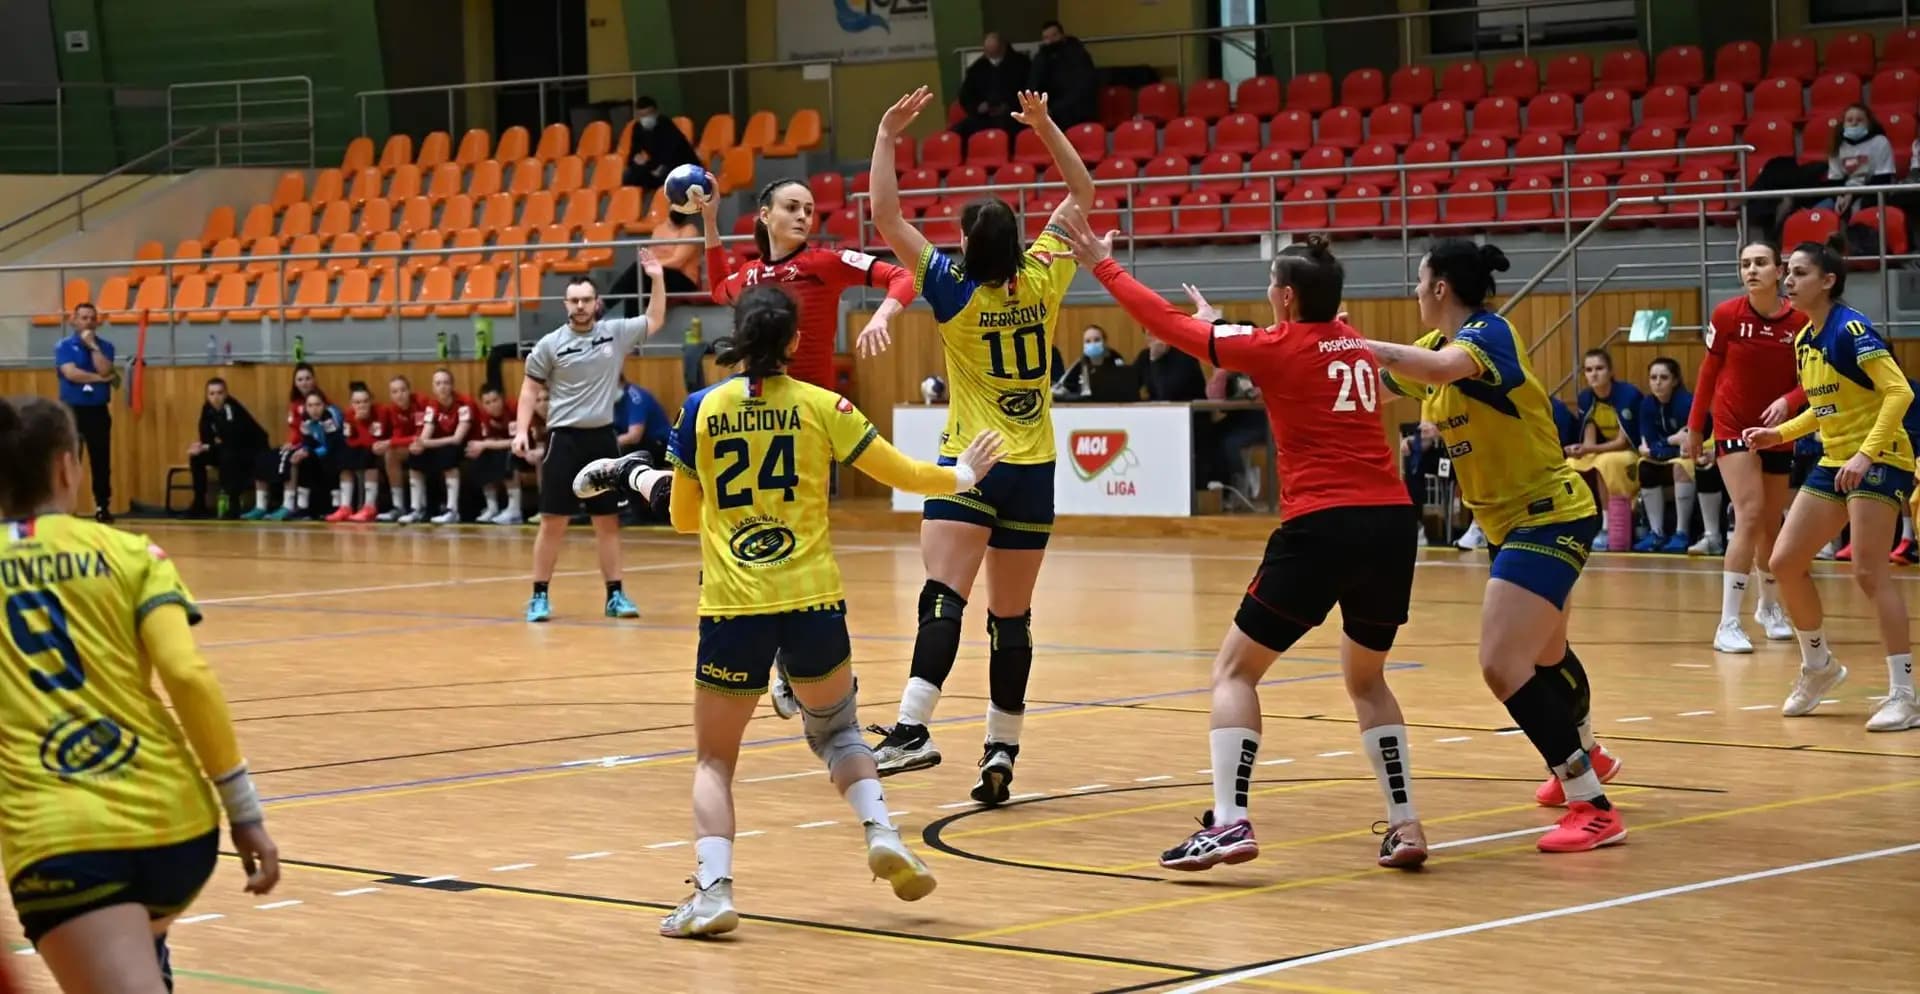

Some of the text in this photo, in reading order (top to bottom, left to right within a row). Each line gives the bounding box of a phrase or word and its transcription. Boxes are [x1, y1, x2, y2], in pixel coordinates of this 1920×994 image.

[746, 267, 758, 285] 21
[1740, 322, 1753, 338] 11
[982, 323, 1047, 379] 10
[1328, 359, 1376, 412] 20
[707, 405, 801, 437] BAJČIOVÁ
[1076, 436, 1108, 456] MOL
[714, 435, 799, 510] 24
[1107, 480, 1136, 496] LIGA
[6, 588, 86, 694] 9
[701, 662, 749, 682] doka
